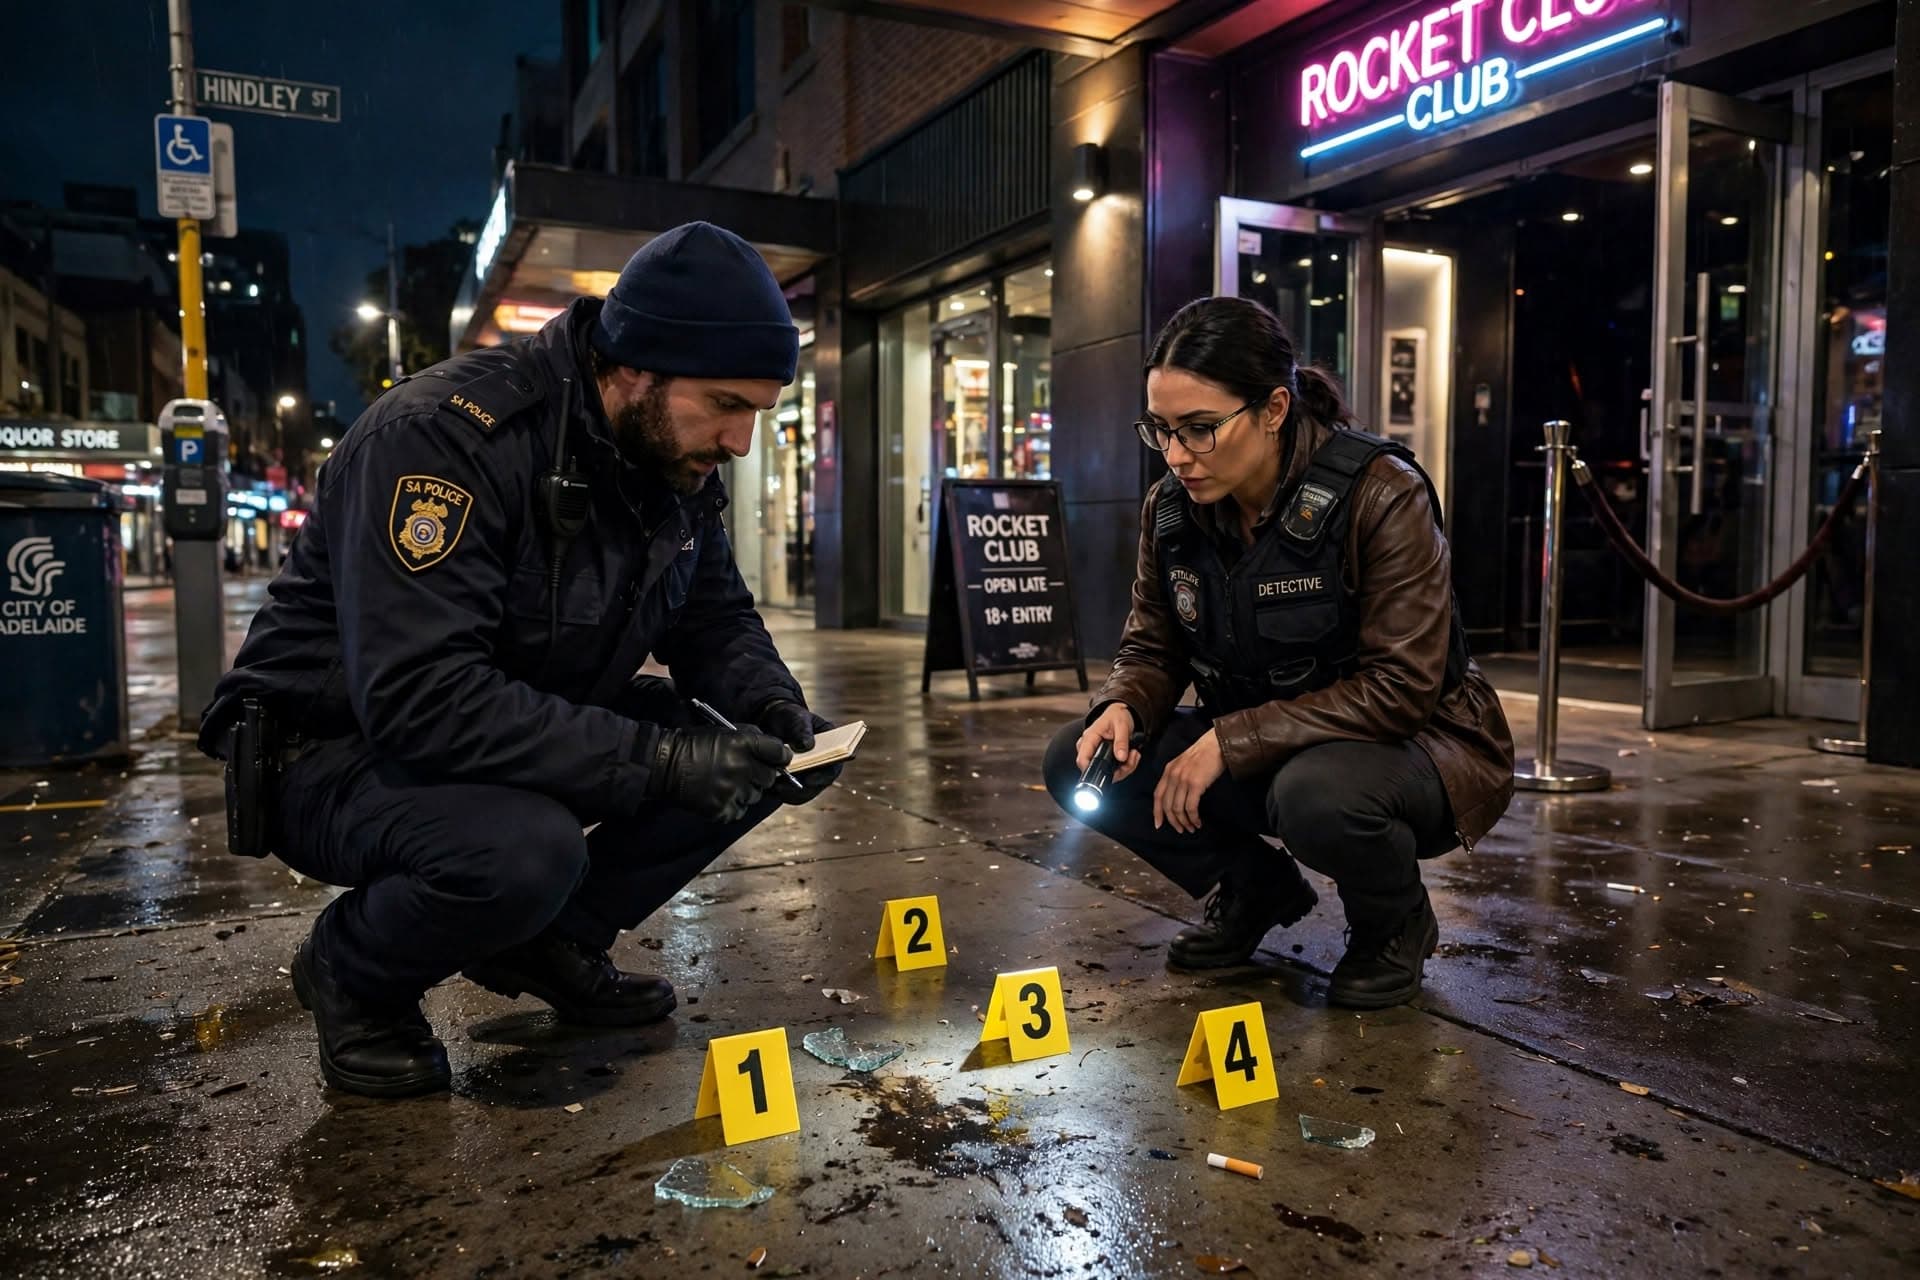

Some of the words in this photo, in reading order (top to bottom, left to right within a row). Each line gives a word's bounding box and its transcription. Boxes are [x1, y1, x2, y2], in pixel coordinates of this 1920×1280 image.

[1301, 0, 1486, 126] ROCKET
[203, 76, 300, 111] HINDLEY
[312, 91, 331, 108] ST
[1406, 57, 1509, 130] CLUB
[451, 394, 464, 406] SA
[464, 401, 496, 427] POLICE
[60, 429, 120, 449] STORE
[182, 440, 198, 462] P
[405, 480, 421, 493] SA
[424, 482, 464, 506] POLICE
[966, 514, 1050, 537] ROCKET
[984, 540, 1040, 562] CLUB
[984, 578, 1016, 594] OPEN
[1019, 577, 1048, 593] LATE
[1258, 577, 1323, 597] DETECTIVE
[2, 600, 46, 617] CITY
[50, 599, 76, 616] OF
[984, 607, 1009, 626] 18+
[1012, 606, 1053, 624] ENTRY
[903, 908, 932, 954] 2
[1019, 982, 1052, 1040] 3
[1224, 1020, 1258, 1082] 4
[737, 1048, 768, 1115] 1
